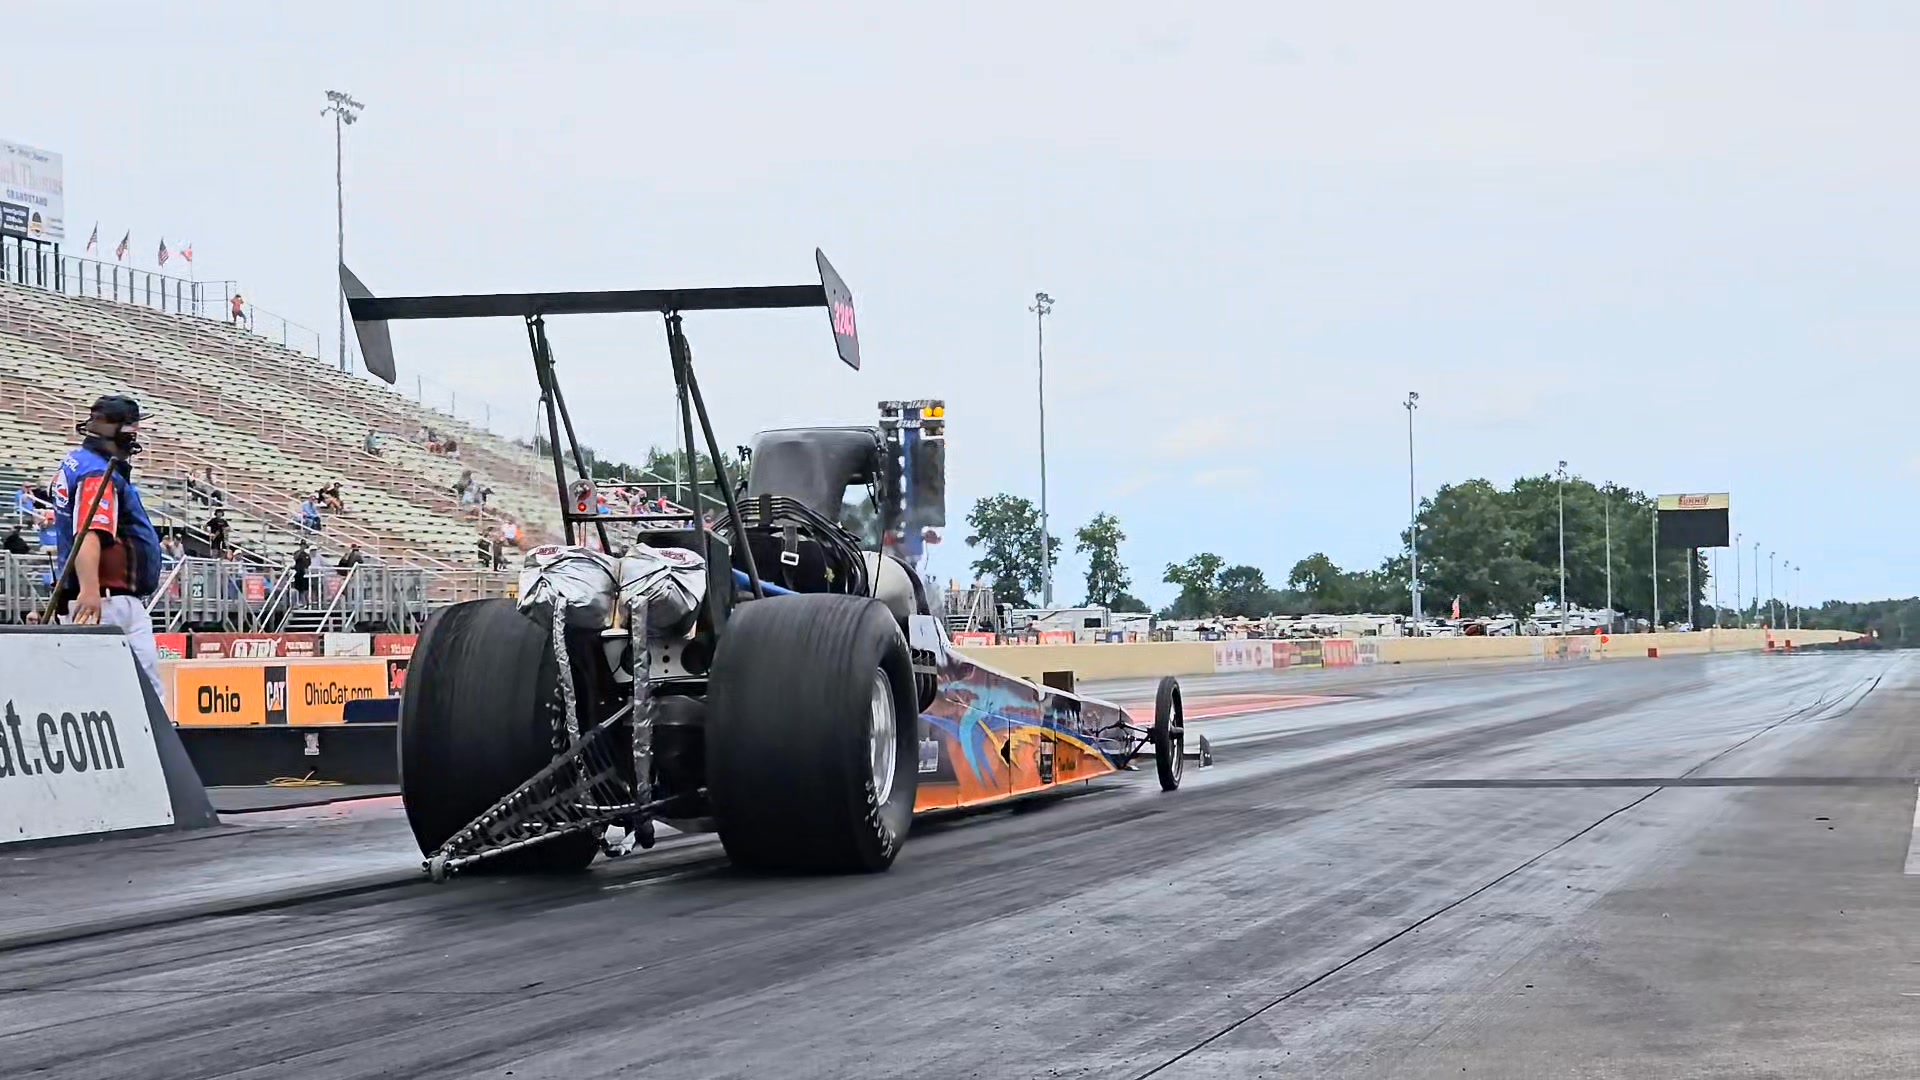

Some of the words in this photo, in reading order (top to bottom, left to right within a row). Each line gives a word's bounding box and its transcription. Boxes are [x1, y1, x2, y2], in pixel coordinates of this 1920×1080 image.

[198, 685, 241, 714] Ohio
[266, 681, 286, 711] CAT
[304, 681, 373, 706] OhioCatcom
